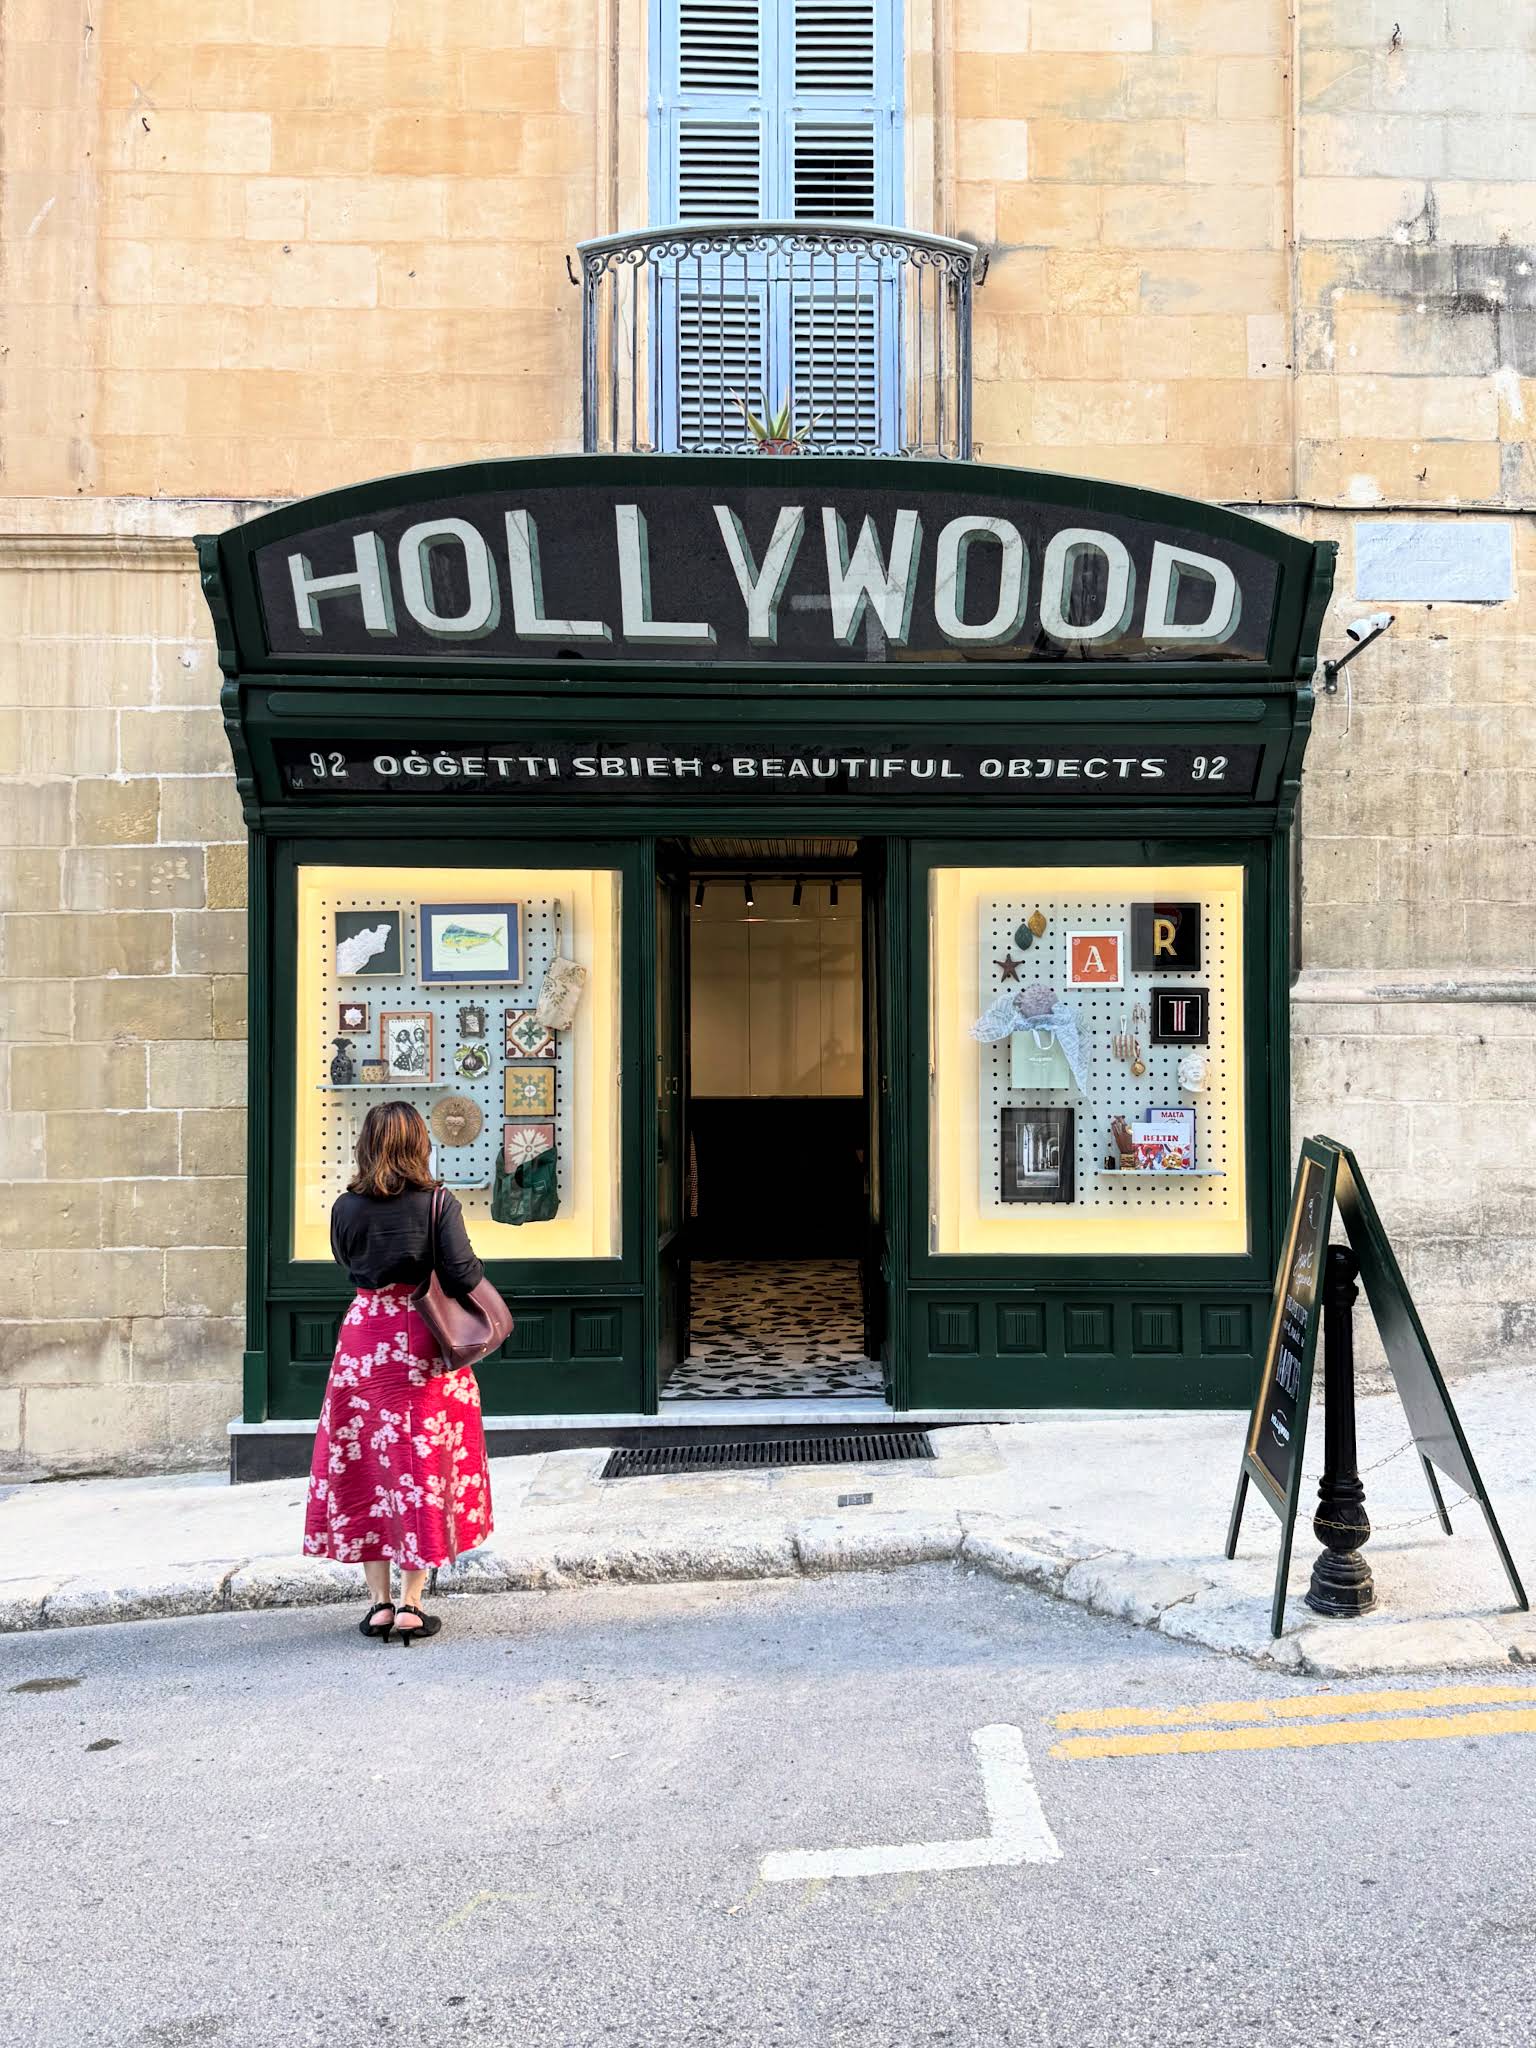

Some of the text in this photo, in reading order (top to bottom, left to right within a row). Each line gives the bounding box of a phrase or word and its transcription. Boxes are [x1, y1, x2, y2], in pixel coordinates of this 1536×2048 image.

[287, 503, 1242, 648] HOLLYWOOD
[309, 751, 349, 778] 92
[372, 750, 560, 778] OĠĠETTI
[732, 757, 963, 779] BEAUTIFUL
[978, 757, 1167, 779] OBJECTS
[1190, 756, 1229, 780] 92
[1152, 918, 1178, 956] R
[1081, 944, 1108, 973] A
[1168, 1000, 1191, 1032] T
